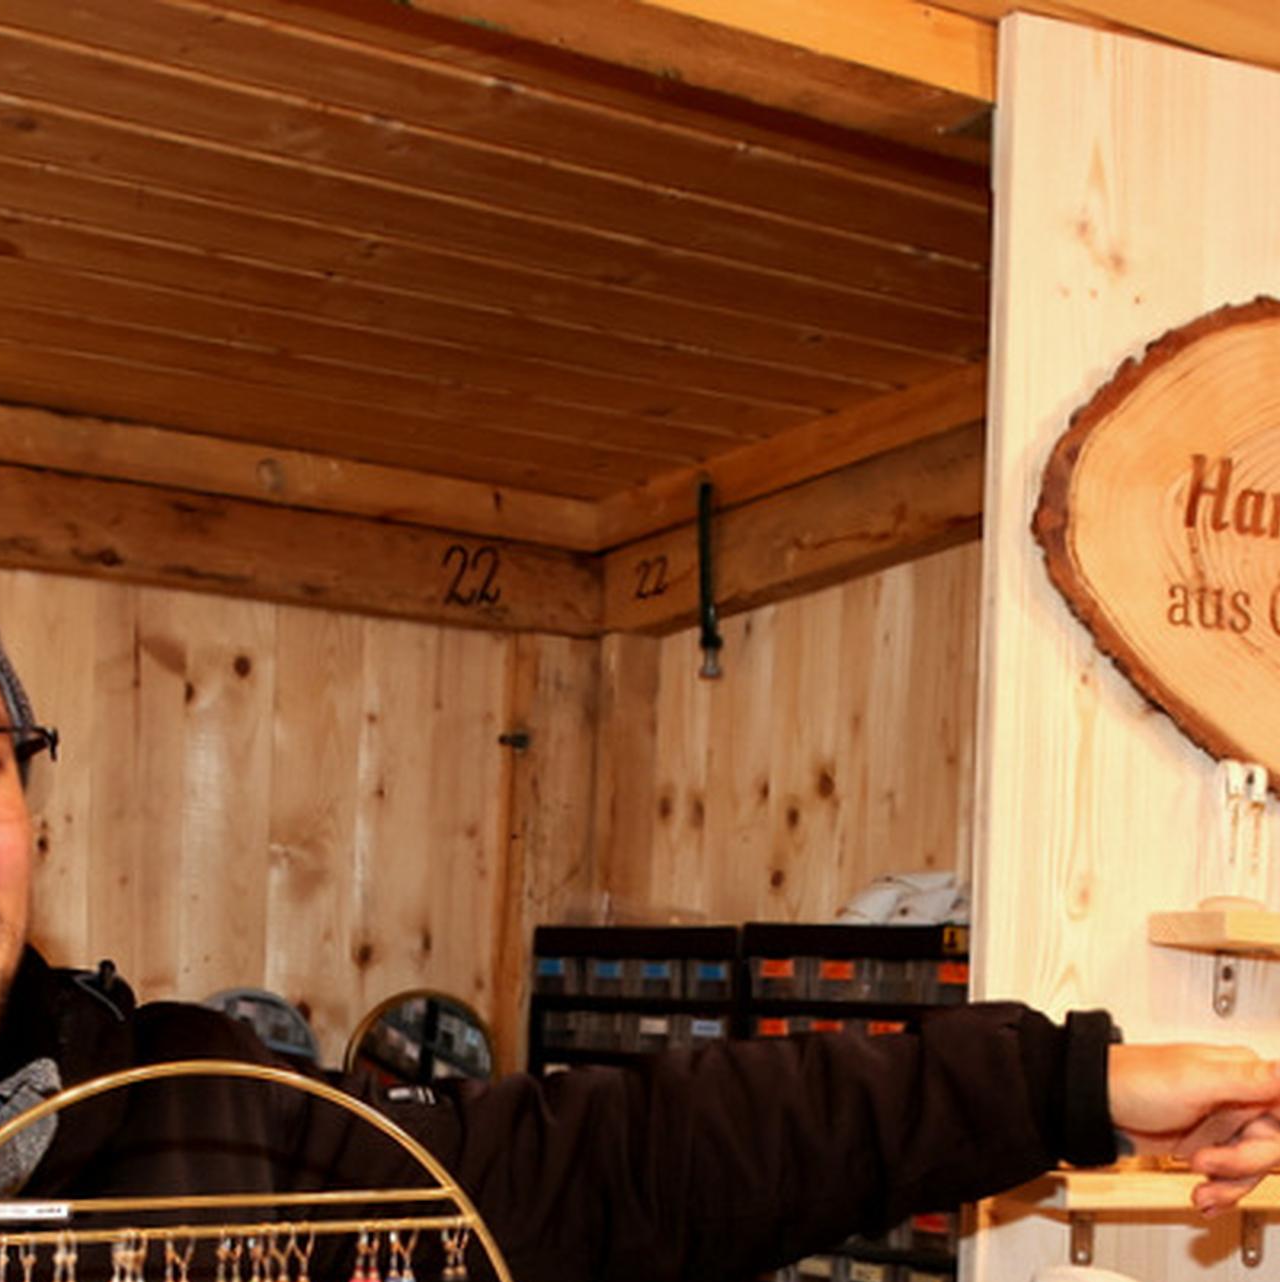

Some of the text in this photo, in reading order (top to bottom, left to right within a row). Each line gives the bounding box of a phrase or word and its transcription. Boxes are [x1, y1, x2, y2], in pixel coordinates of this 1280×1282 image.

[441, 544, 502, 607] 22
[634, 555, 669, 600] 22
[1167, 581, 1253, 635] aus
